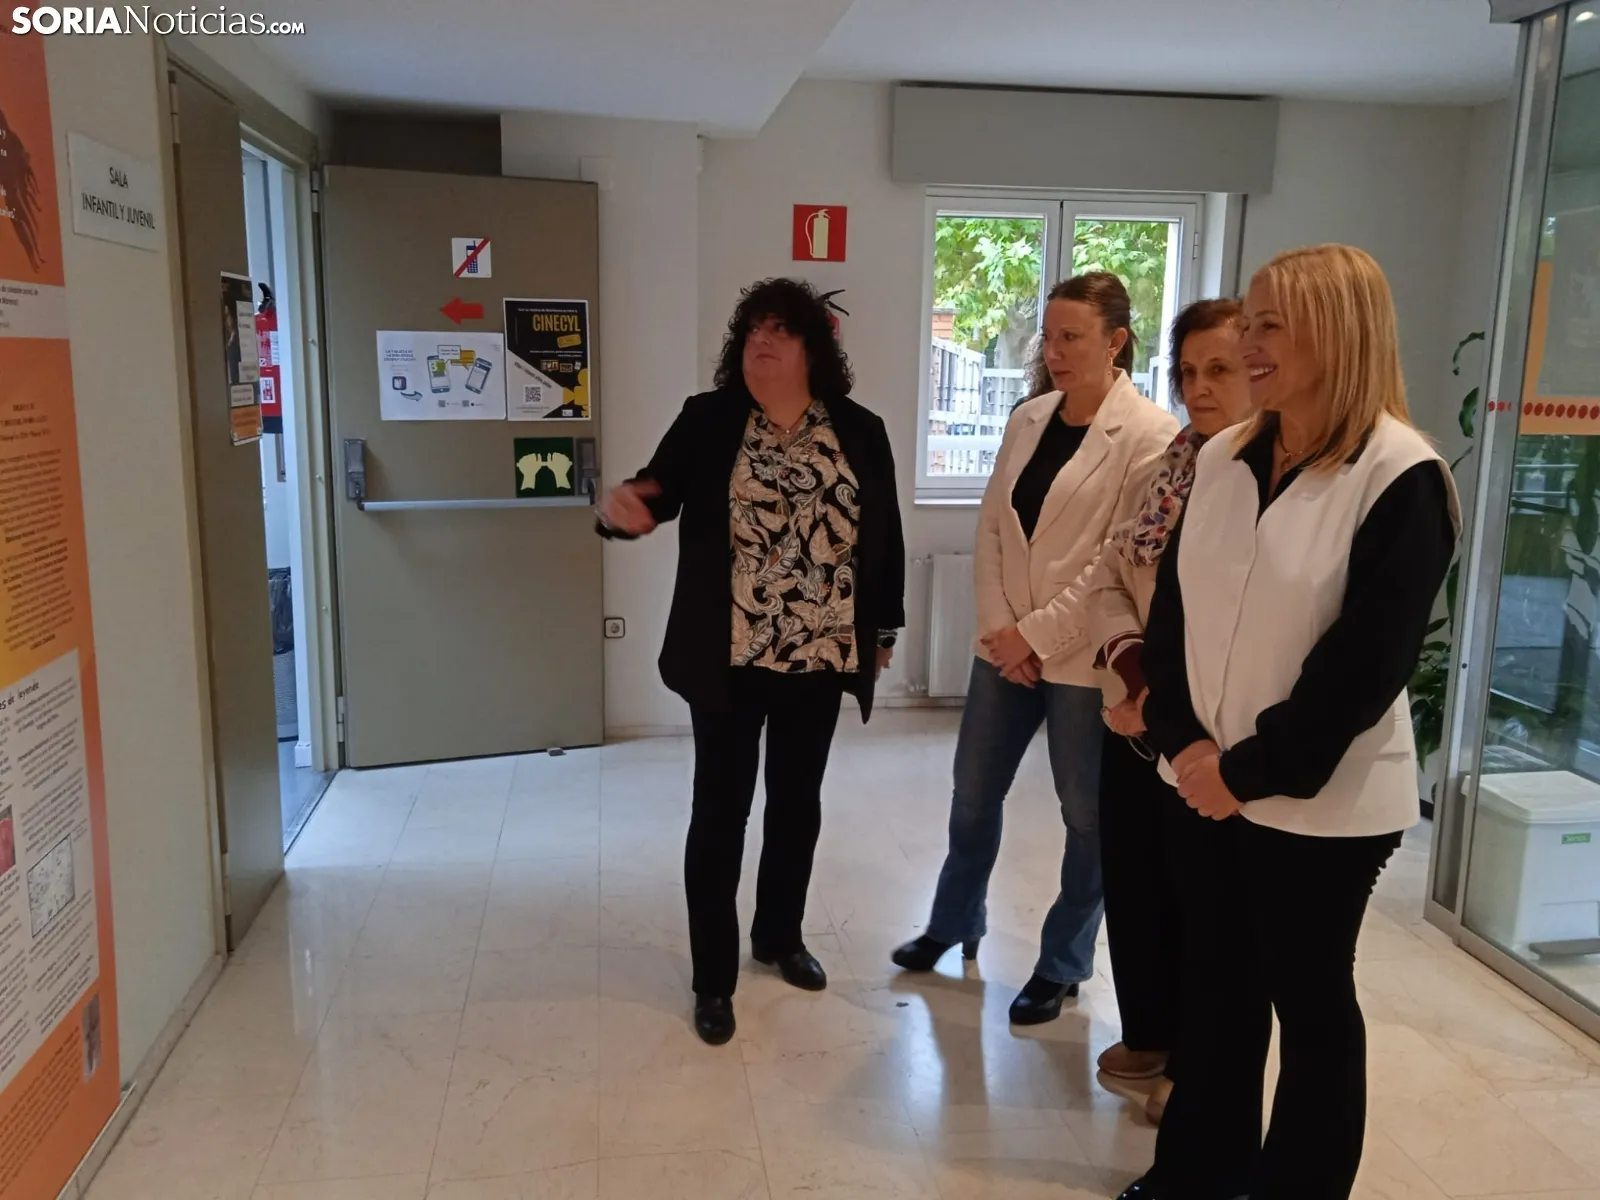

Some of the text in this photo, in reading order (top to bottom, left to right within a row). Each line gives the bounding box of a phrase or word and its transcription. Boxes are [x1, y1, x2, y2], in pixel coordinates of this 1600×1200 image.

[109, 166, 129, 189] SALA
[81, 192, 156, 230] INFANTIL Y JUVENIL
[532, 313, 581, 332] CINECYL
